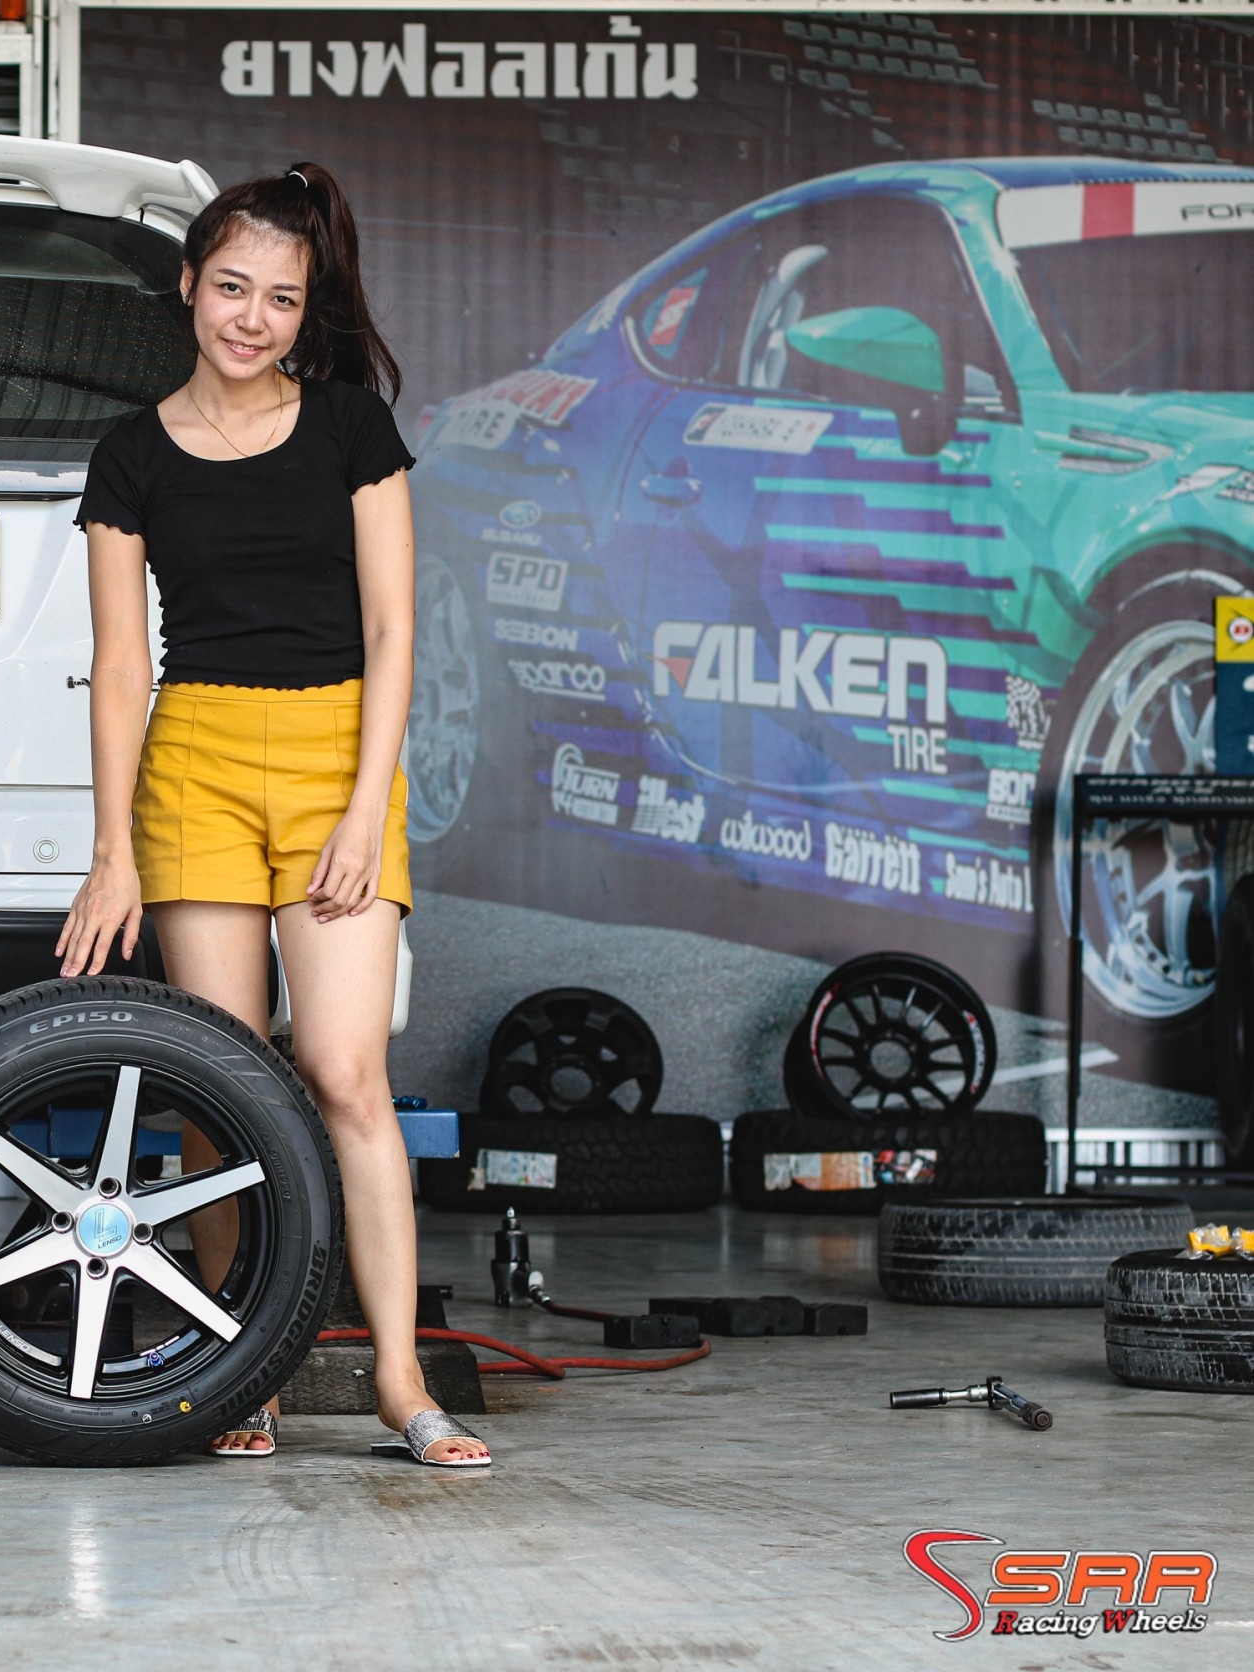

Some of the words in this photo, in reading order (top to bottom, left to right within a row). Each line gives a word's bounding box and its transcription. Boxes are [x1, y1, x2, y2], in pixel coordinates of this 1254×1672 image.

[507, 659, 606, 694] sparco
[652, 621, 948, 725] FALKEN
[888, 725, 948, 775] TIRE
[28, 1010, 133, 1034] EP150
[98, 1235, 122, 1249] LENSO
[212, 1243, 327, 1420] BRIDGESTONE
